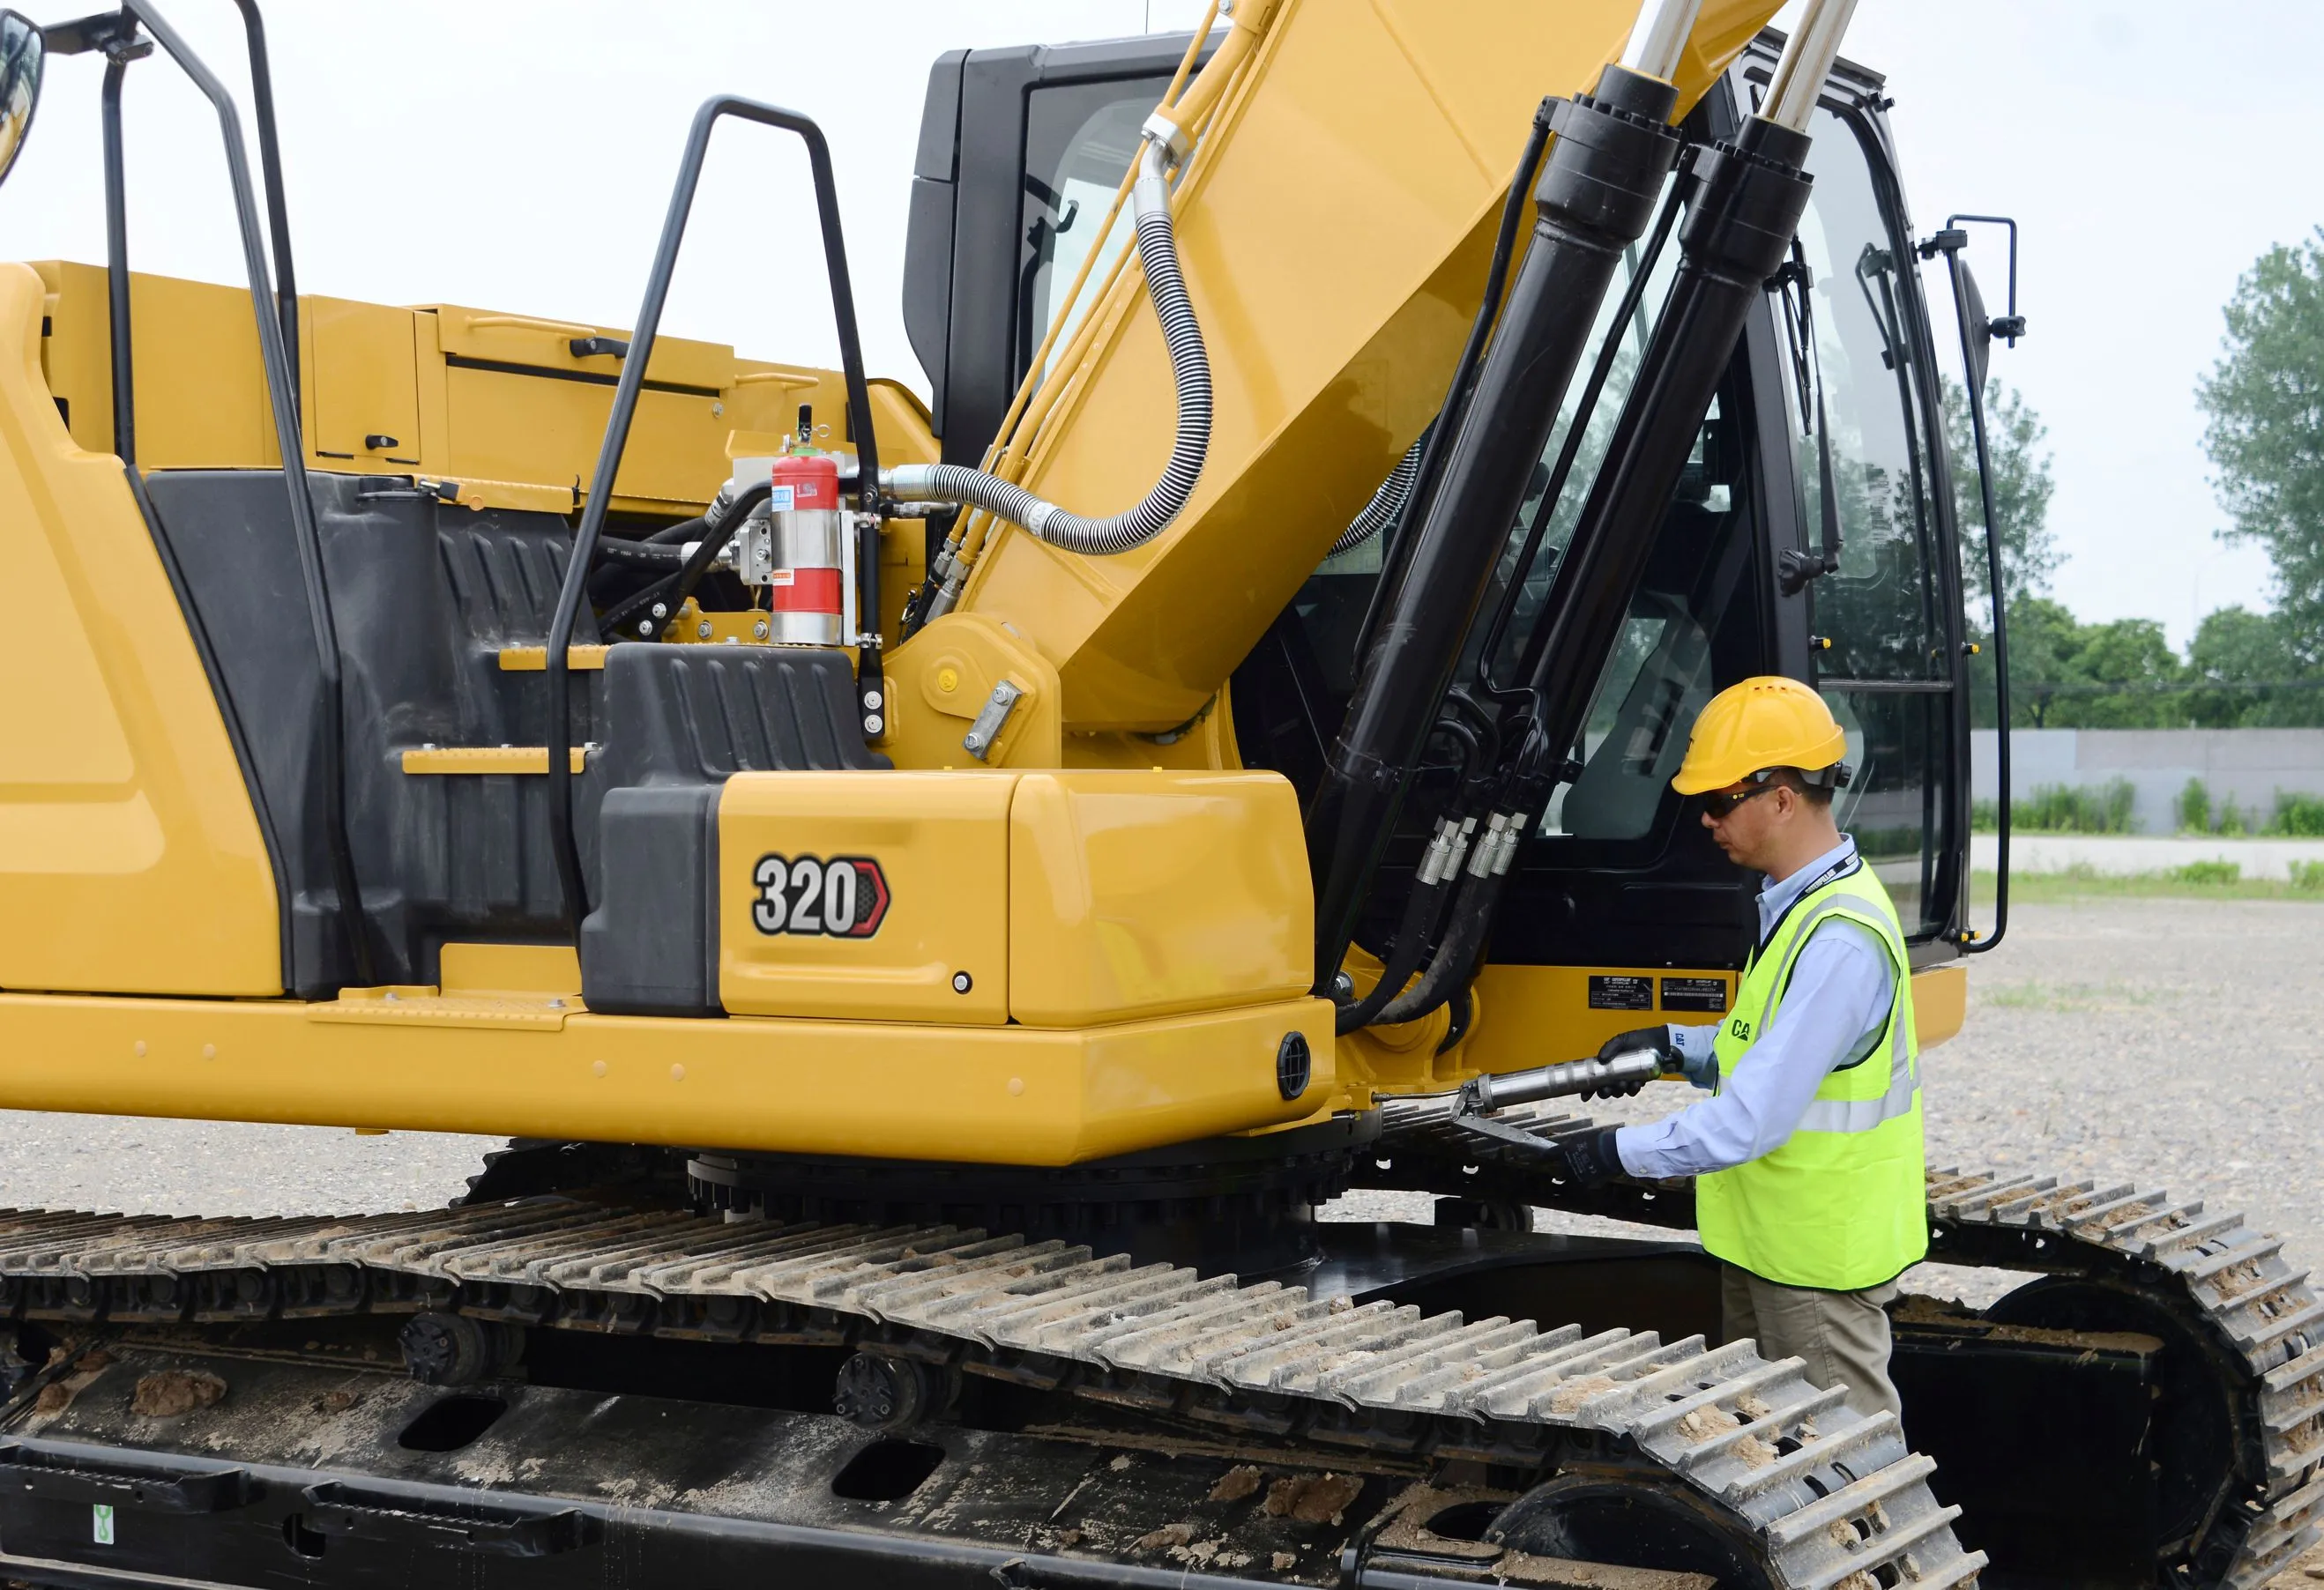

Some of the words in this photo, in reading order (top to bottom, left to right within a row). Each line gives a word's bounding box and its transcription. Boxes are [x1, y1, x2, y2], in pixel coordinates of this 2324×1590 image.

[755, 858, 857, 934] 320
[1675, 1033, 1686, 1047] CAT
[1732, 1019, 1751, 1042] CA
